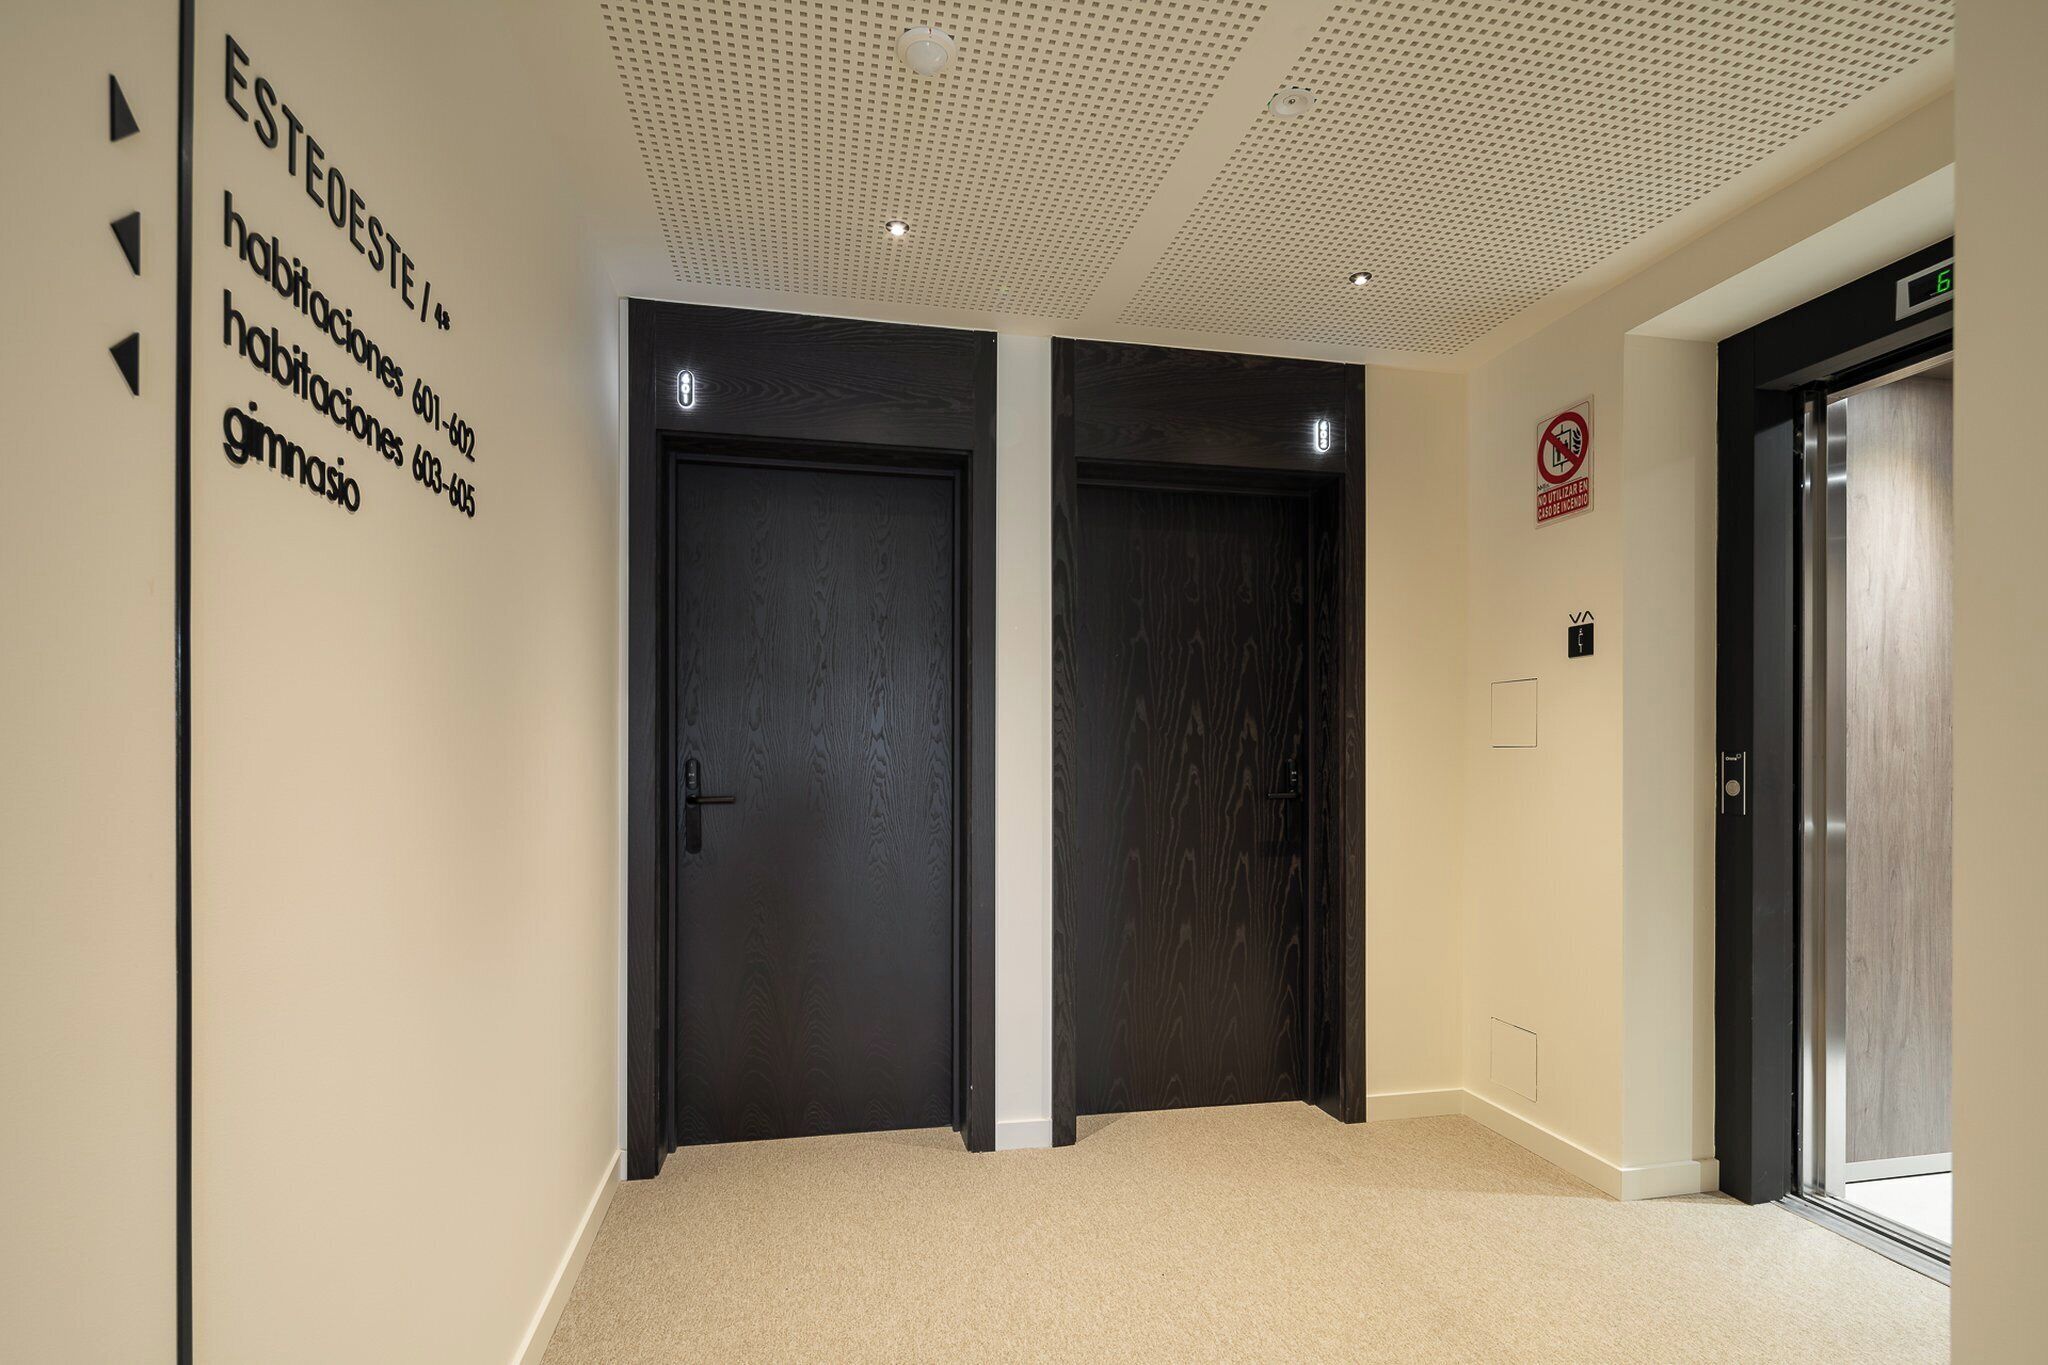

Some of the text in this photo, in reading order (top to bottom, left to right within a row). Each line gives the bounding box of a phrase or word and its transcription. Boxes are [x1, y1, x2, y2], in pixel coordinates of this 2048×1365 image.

[225, 35, 415, 310] ESTEOESTE
[224, 190, 476, 463] habitaciones 601-602
[1937, 269, 1951, 293] 6
[223, 401, 361, 513] gimnasio
[224, 288, 476, 518] habitaciones 603-605
[1538, 494, 1548, 506] NO
[1548, 483, 1578, 503] UTILIZAR
[1578, 479, 1588, 493] EN
[1538, 493, 1588, 520] CASO DE INCENDIO
